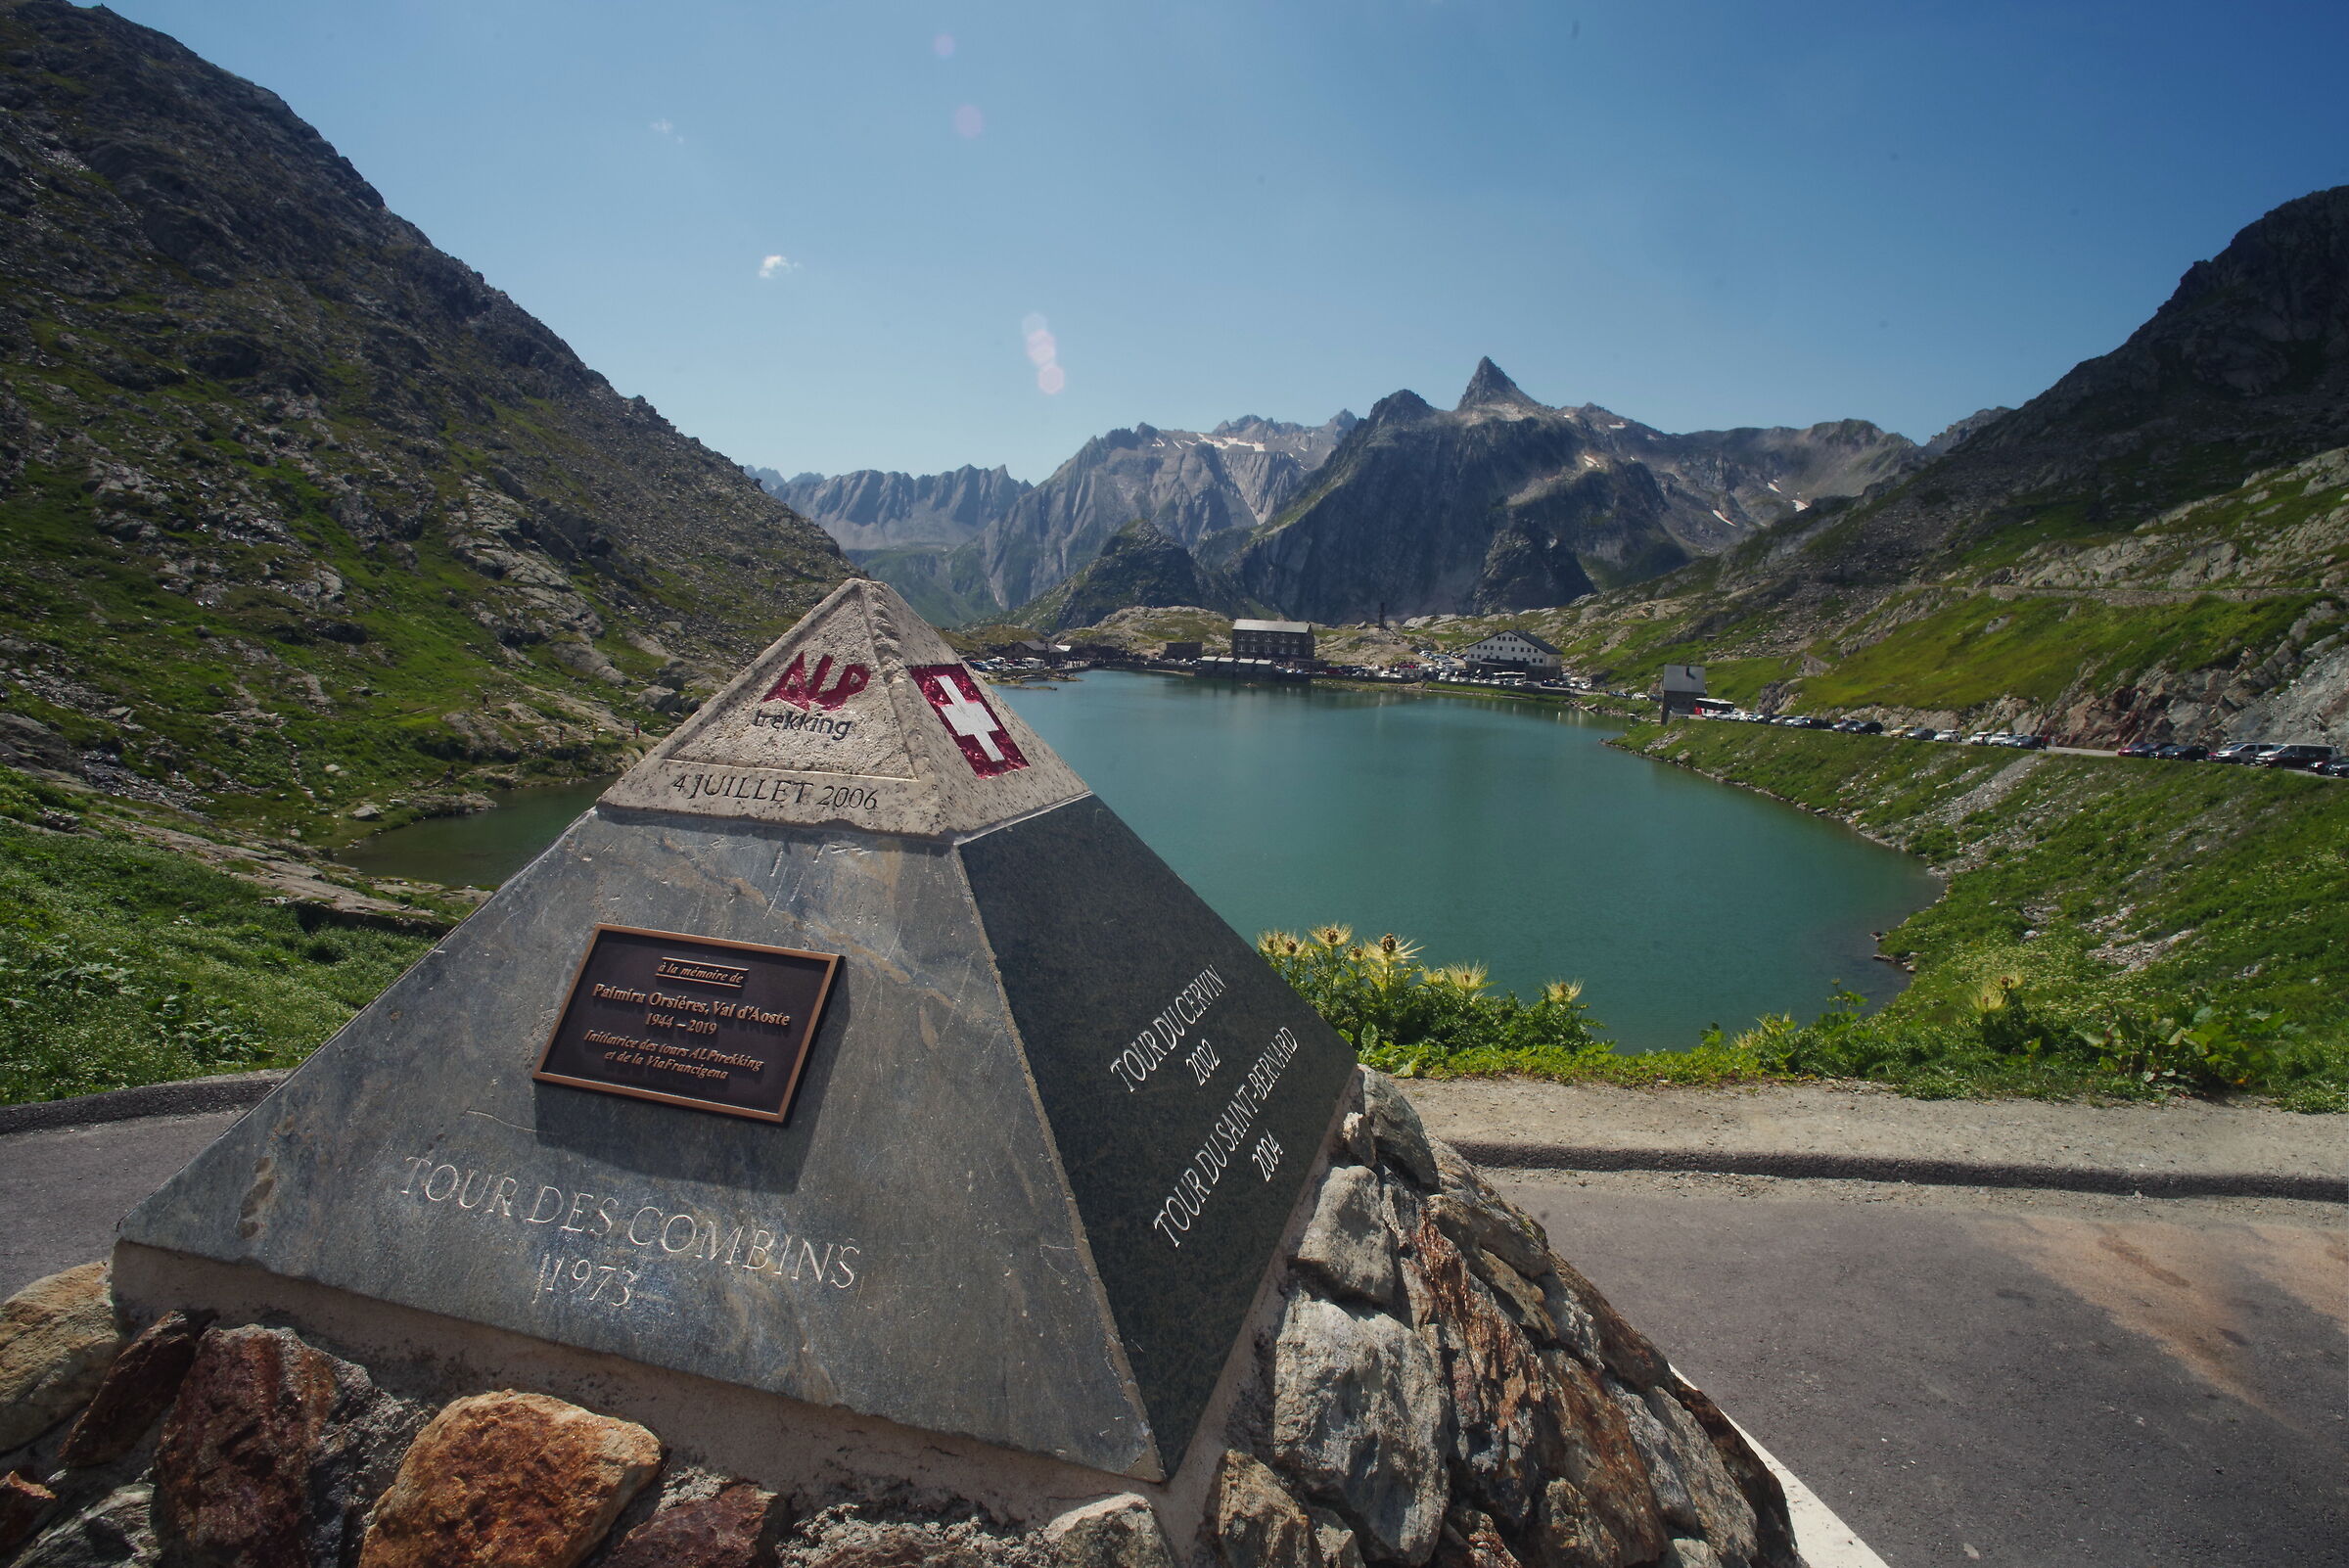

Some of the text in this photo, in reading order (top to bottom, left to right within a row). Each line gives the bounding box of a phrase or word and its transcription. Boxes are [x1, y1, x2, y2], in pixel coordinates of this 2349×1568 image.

[753, 709, 853, 741] trekking
[672, 774, 879, 810] 4 JUILLET 2006
[658, 961, 745, 984] à la mémoire de
[591, 983, 646, 1004] Palmira
[712, 1000, 737, 1018] Val
[737, 1005, 791, 1027] d'Aoste
[645, 1012, 673, 1029] 1944
[686, 1019, 718, 1036] 2019
[1110, 964, 1228, 1093] TOUR DU CERVIN
[583, 1030, 764, 1072] Initiatrice des tours ALPtrekking
[604, 1051, 615, 1061] et
[617, 1050, 632, 1064] de
[633, 1054, 643, 1066] la
[1185, 1038, 1221, 1086] 2002
[1252, 1129, 1285, 1182] 2004
[1153, 1167, 1212, 1248] TOUR
[1194, 1133, 1228, 1185] DU
[401, 1156, 861, 1289] TOUR DES COMBINS
